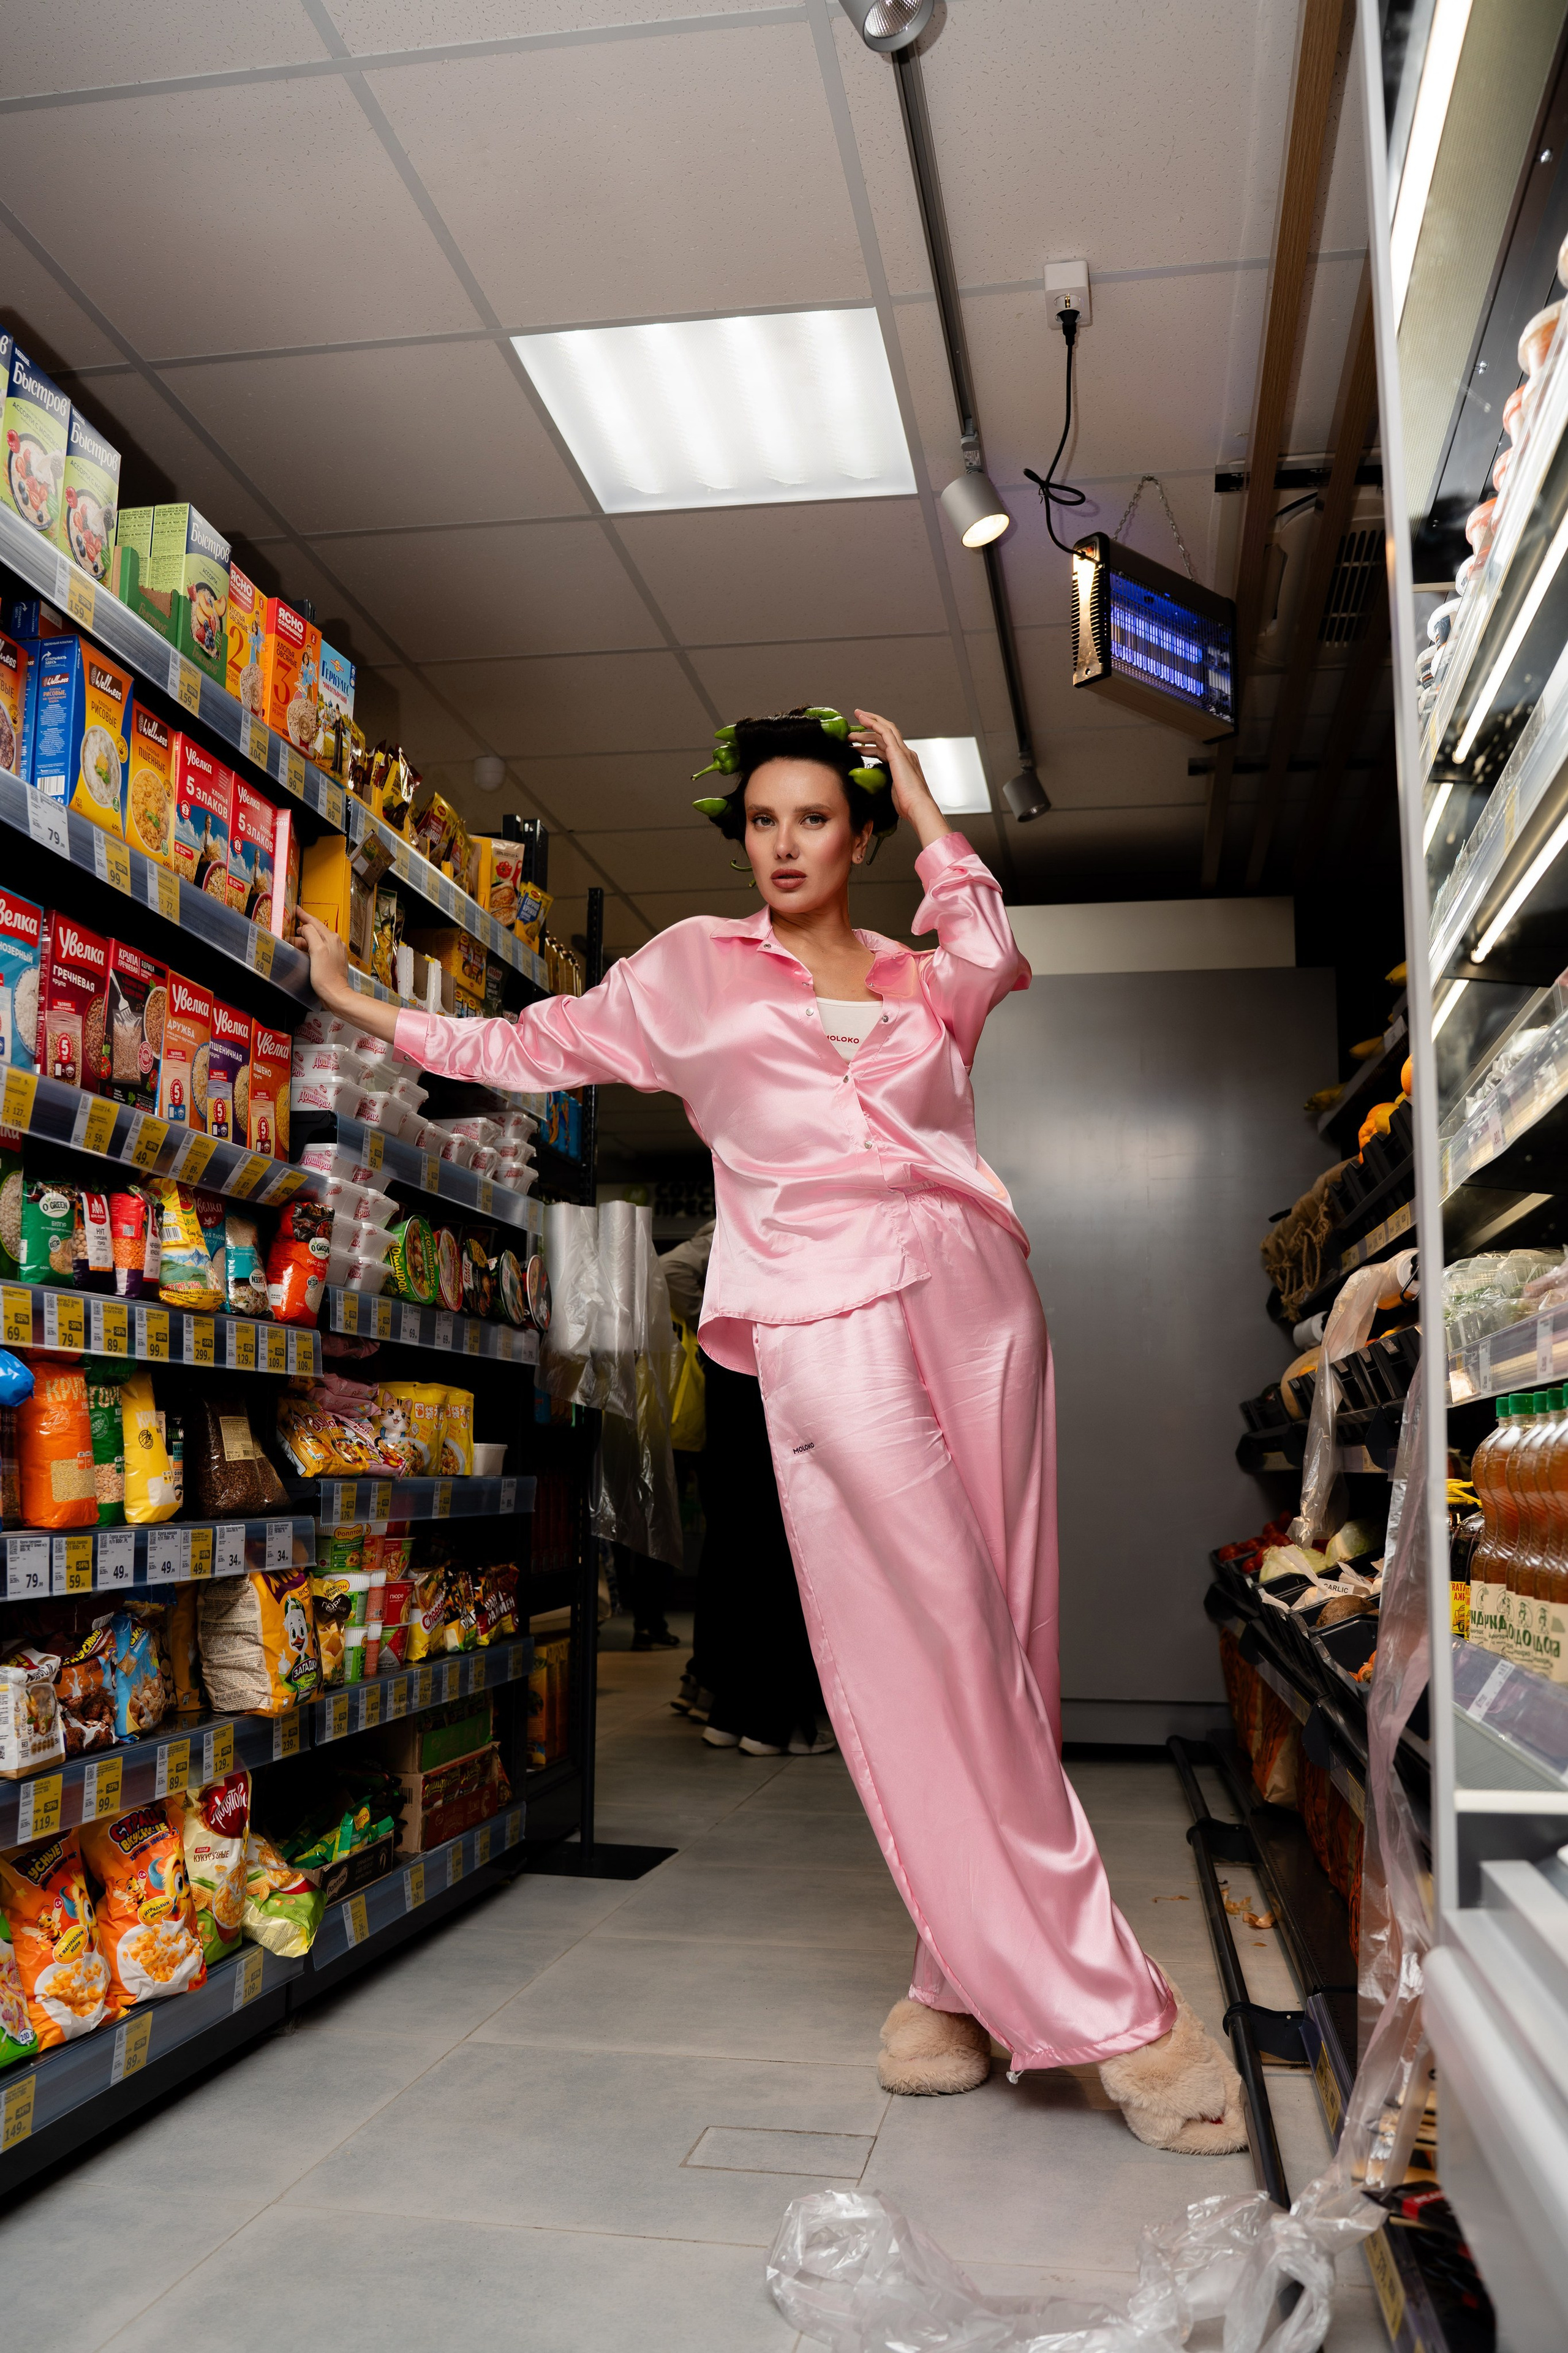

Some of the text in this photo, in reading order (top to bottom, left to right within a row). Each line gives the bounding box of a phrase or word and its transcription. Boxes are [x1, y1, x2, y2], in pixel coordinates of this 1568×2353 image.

[13, 361, 67, 416] Быстров
[12, 401, 35, 425] АССОРТИ
[70, 421, 117, 472] Быстров
[70, 460, 91, 481] АССОРТИ
[190, 523, 230, 564] Быстров
[202, 567, 218, 584] АССОРТИ
[230, 569, 254, 597] ЯСНО
[230, 581, 252, 605] СОЛНЫШКО
[69, 600, 85, 619] 159
[229, 604, 246, 622] ХЛОПЬЯ
[230, 613, 248, 634] ОВСЯНЫЕ
[278, 607, 304, 633] ЯСНО
[278, 618, 303, 640] СОЛНЫШКО
[227, 625, 244, 673] 2
[277, 641, 295, 659] ХЛОПЬЯ
[276, 648, 298, 669] ОВСЯНЫЕ
[47, 676, 69, 687] Wellness
[95, 671, 122, 701] Wellness
[226, 673, 239, 686] РАЗМЕР
[274, 659, 292, 705] 3
[321, 660, 350, 697] ГЕРКУЛЕС
[179, 689, 192, 706] 159
[91, 700, 118, 729] РИСОВЫЕ
[143, 718, 168, 748] Wellness
[138, 746, 166, 775] ПШЕННЫЕ
[185, 746, 213, 775] Увелка
[250, 746, 262, 763] 104
[288, 777, 297, 791] 99
[186, 775, 228, 820] 5 ЗЛАКОВ
[211, 788, 228, 806] ХЛОПЬЯ
[237, 785, 260, 811] Увелка
[328, 807, 335, 821] 89
[47, 827, 60, 845] 79
[238, 812, 273, 853] 5 ЗЛАКОВ
[110, 869, 121, 885] 99
[0, 899, 37, 935] велка
[59, 926, 104, 966] Увелка
[119, 948, 138, 967] КРУПА
[118, 959, 138, 975] ГРЕЧНЕВАЯ
[141, 960, 155, 973] ЯДРИЦА
[256, 961, 264, 973] 69
[52, 978, 66, 988] крупа
[53, 964, 95, 993] ГРЕЧНЕВАЯ
[172, 984, 209, 1018] Увелка
[167, 1019, 195, 1039] ДРУЖБА
[213, 1007, 249, 1039] Увелка
[61, 1040, 69, 1056] 5
[209, 1041, 243, 1063] ПШЕНИЧНАЯ
[257, 1031, 290, 1060] Увелка
[254, 1062, 272, 1078] ПШЕНО
[312, 1056, 340, 1071] Доширак
[174, 1086, 179, 1100] 5
[298, 1090, 332, 1109] Доширак
[217, 1104, 223, 1117] 5
[261, 1123, 266, 1135] 5
[94, 1134, 103, 1143] 59
[136, 1150, 148, 1164] 49
[300, 1153, 332, 1171] Доширак
[50, 1200, 68, 1210] GREEN
[423, 1229, 435, 1288] Доширак
[7, 1326, 20, 1342] 69
[345, 1320, 352, 1331] 64
[379, 1326, 385, 1336] 69
[409, 1328, 415, 1339] 69
[62, 1332, 73, 1347] 79
[107, 1338, 118, 1352] 89
[443, 1334, 449, 1344] 69
[149, 1343, 160, 1357] 99
[195, 1349, 208, 1361] 299
[237, 1354, 249, 1365] 129
[268, 1357, 280, 1368] 109
[298, 1360, 308, 1371] 109
[793, 1442, 815, 1455] MOLOKO
[341, 1511, 350, 1521] 179
[376, 1508, 386, 1518] 174
[229, 1554, 238, 1566] 34
[277, 1549, 285, 1561] 34
[194, 1562, 203, 1574] 49
[69, 1574, 81, 1588] 59
[1323, 1583, 1349, 1594] GARLIC
[422, 1601, 445, 1630] Cheese
[293, 1658, 317, 1677] ЗАГАДКИ
[282, 1739, 294, 1752] 239
[214, 1758, 227, 1772] 129
[170, 1775, 179, 1790] 89
[99, 1796, 110, 1813] 99
[34, 1815, 51, 1832] 119
[194, 1850, 230, 1863] КУКУРУЗНЫЕ
[62, 1930, 85, 1954] НАТУРАЛЬНЫМ
[20, 2032, 30, 2042] 200
[126, 2053, 137, 2071] 89
[4, 2121, 22, 2142] 149
